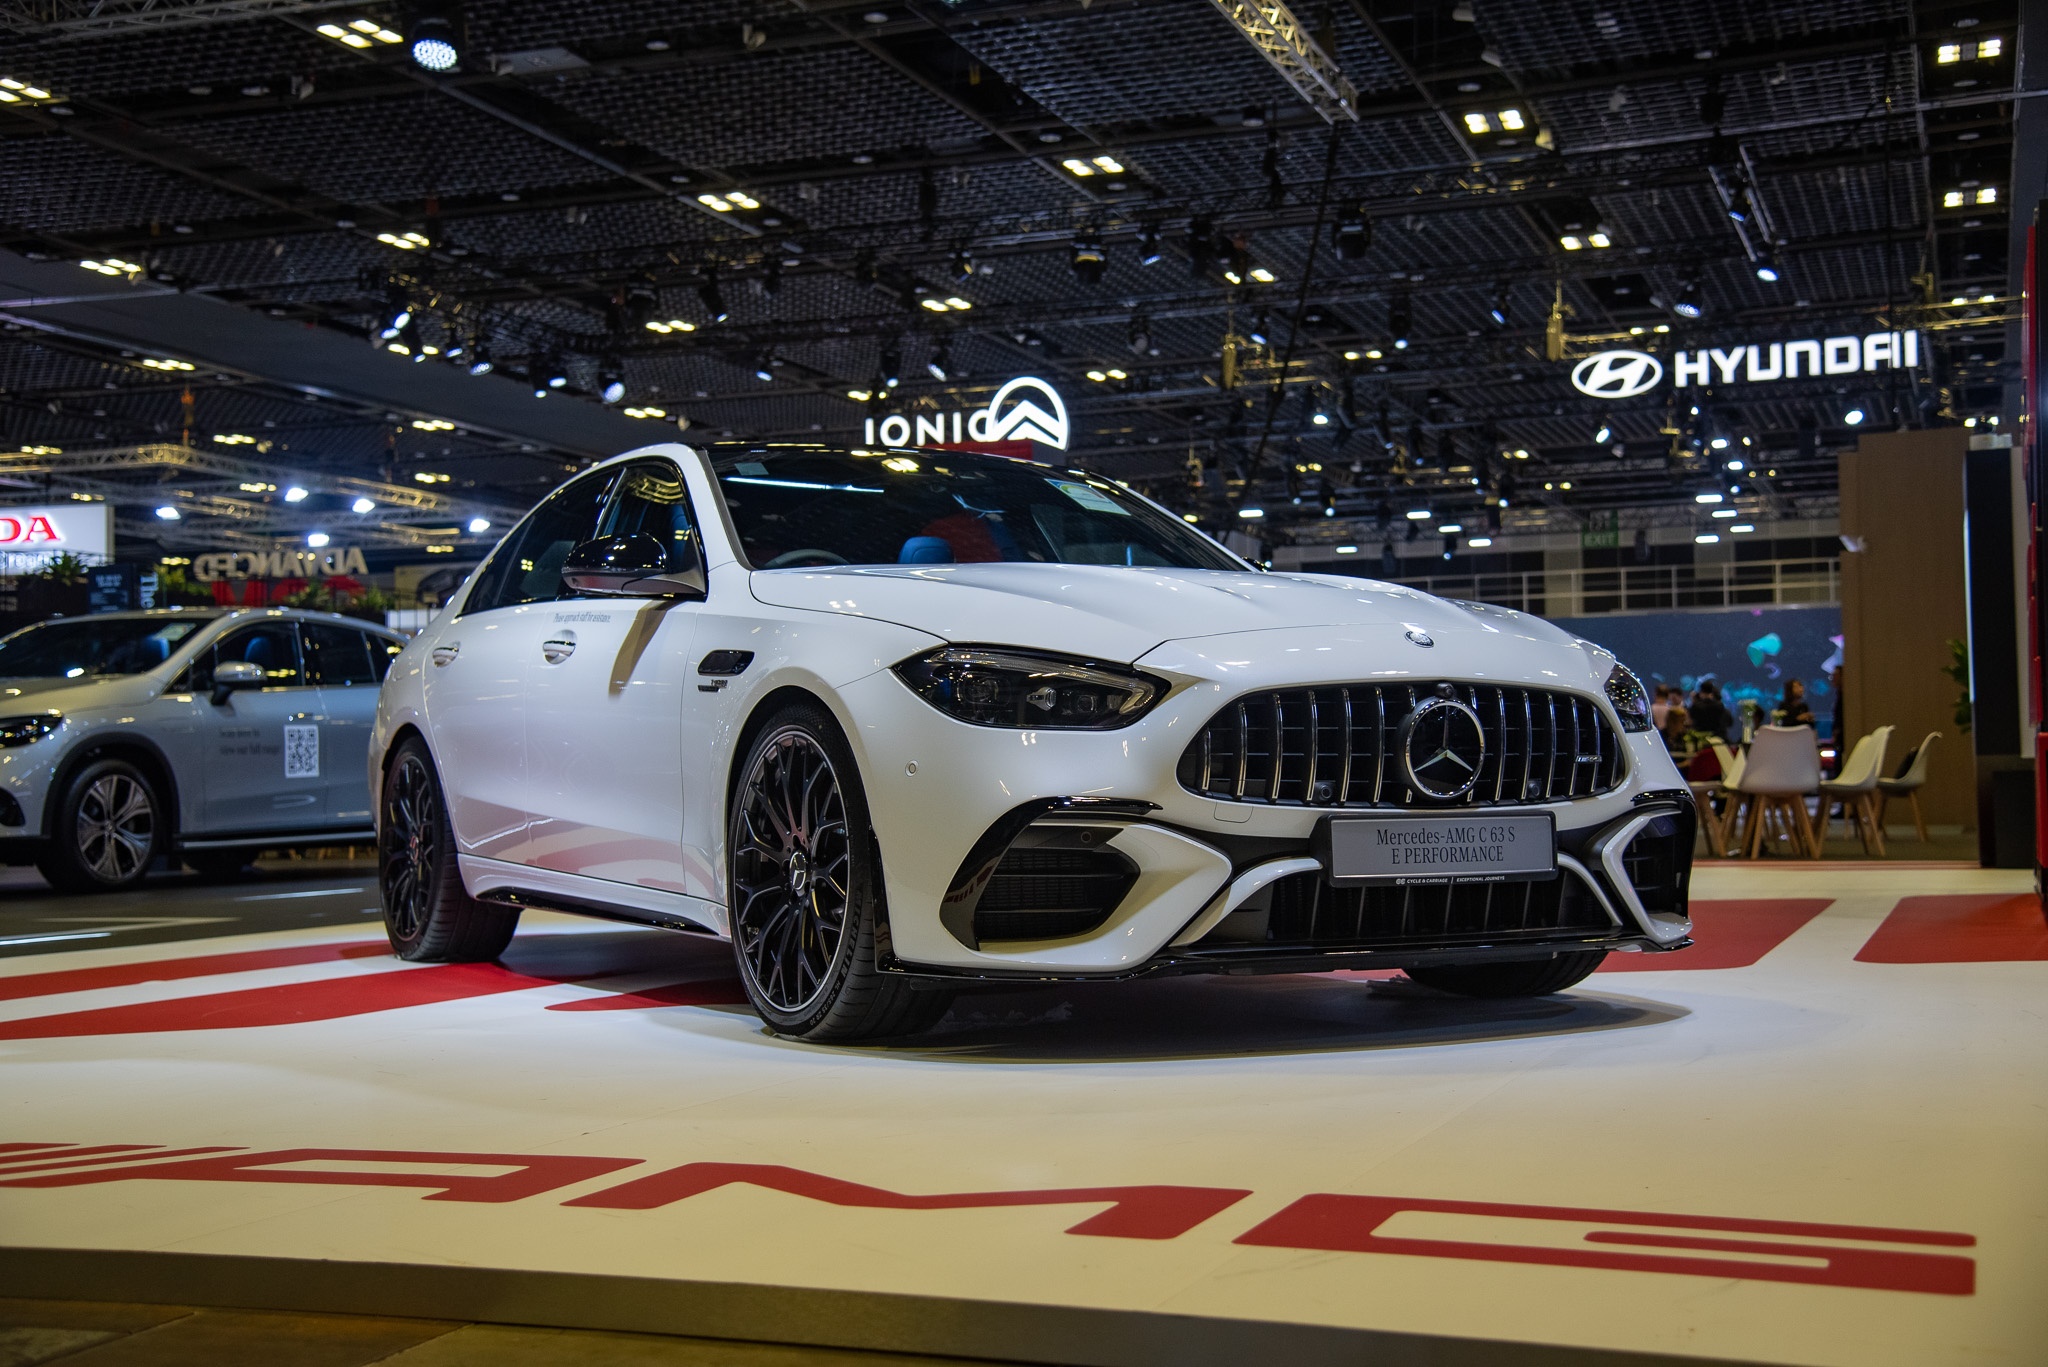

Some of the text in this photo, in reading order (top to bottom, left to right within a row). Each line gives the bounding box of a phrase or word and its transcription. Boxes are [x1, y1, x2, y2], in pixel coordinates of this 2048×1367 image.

[1674, 330, 1918, 387] HYUNDAI
[1584, 532, 1615, 546] EXIT
[1376, 826, 1516, 846] Mercedes-AMG C 63 S
[1391, 845, 1505, 865] E PERFORMANCE
[0, 1147, 1976, 1295] AMG
